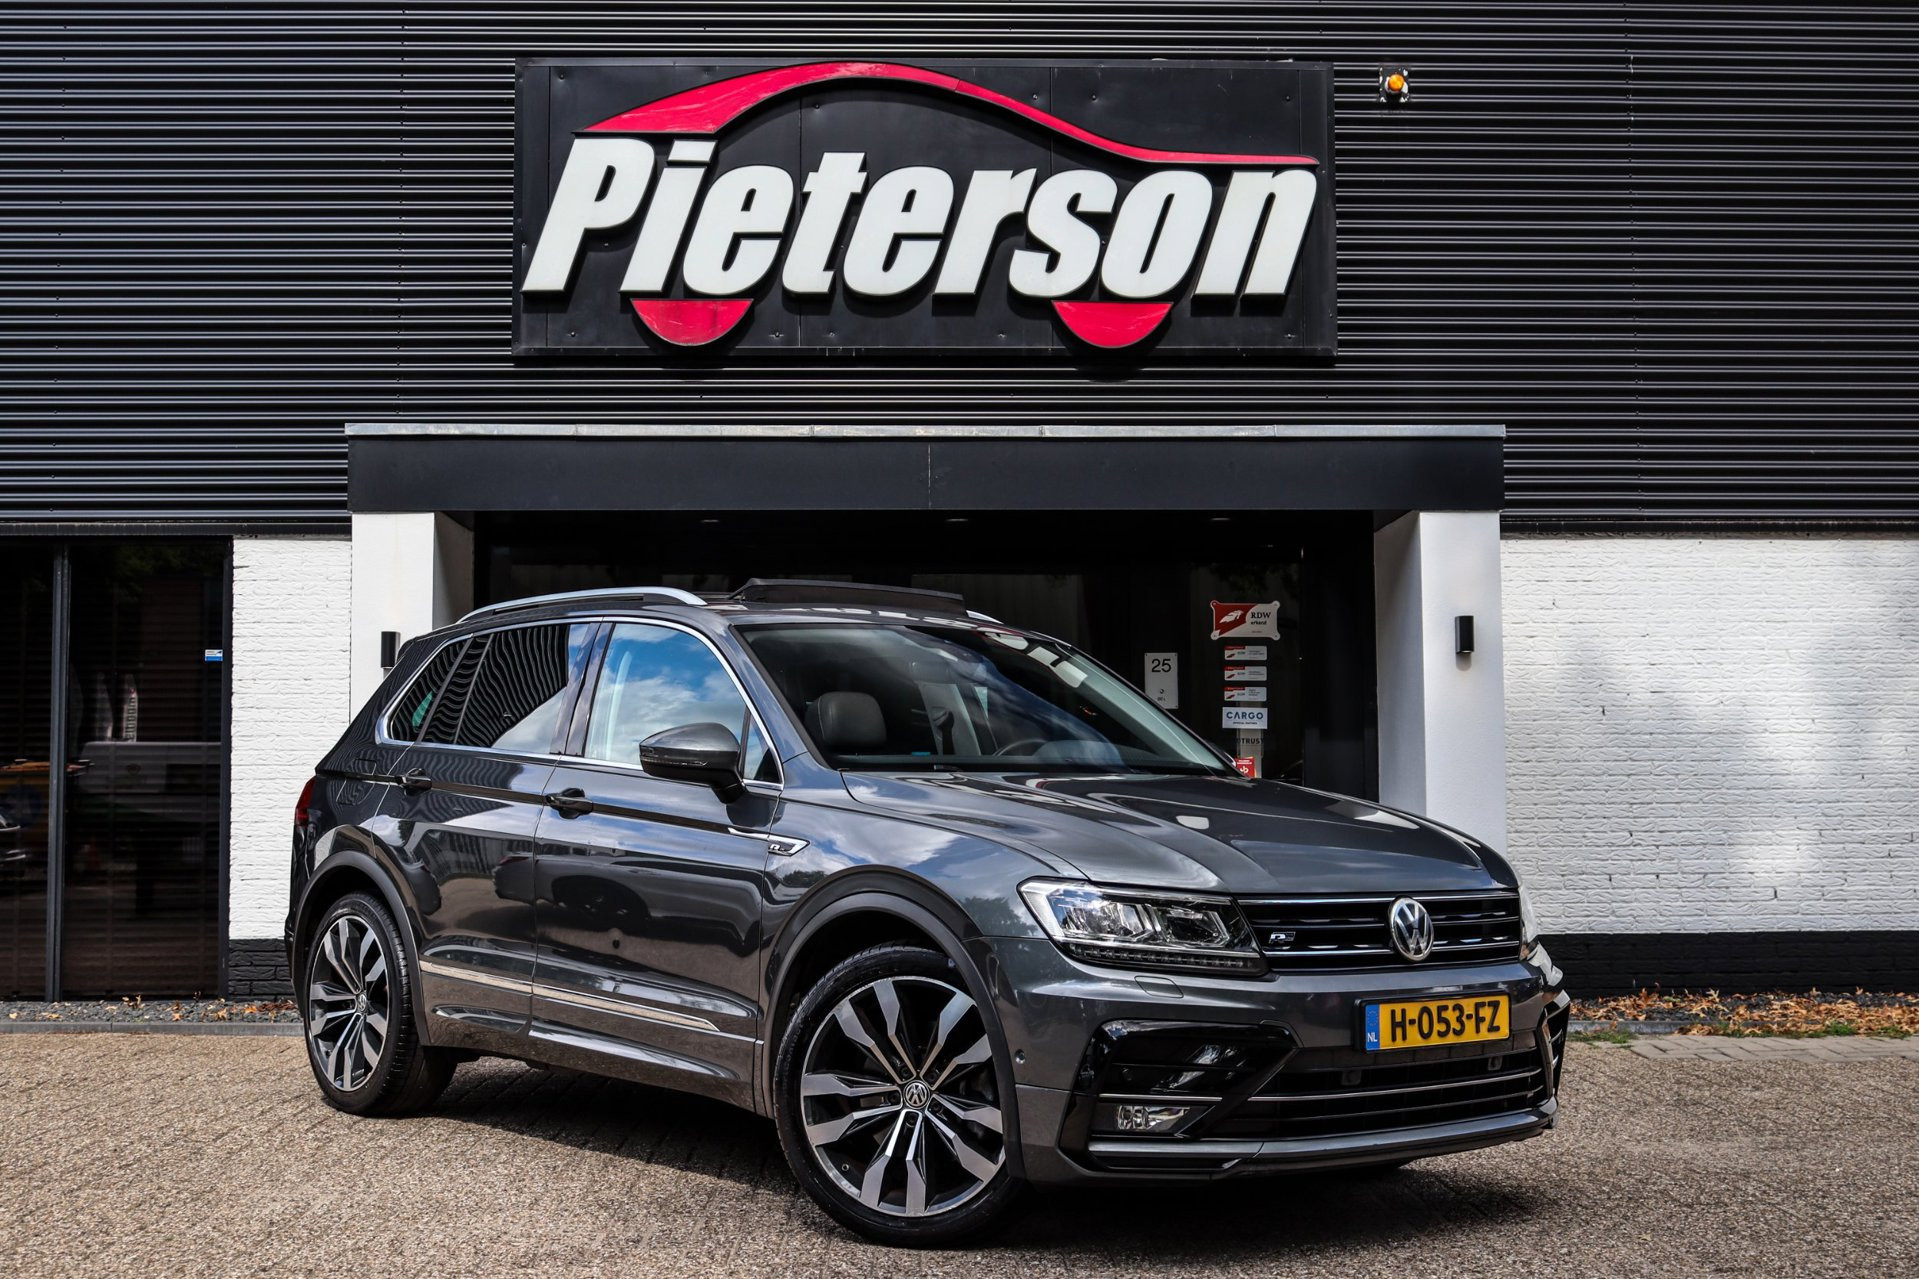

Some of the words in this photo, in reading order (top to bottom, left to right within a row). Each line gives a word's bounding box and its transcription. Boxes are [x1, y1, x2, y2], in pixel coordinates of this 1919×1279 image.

[520, 136, 1318, 299] Pieterson
[1250, 611, 1271, 619] RDW
[1151, 658, 1172, 673] 25
[1226, 711, 1264, 720] CARGO
[1390, 1000, 1501, 1042] H-053-FZ
[1366, 1032, 1378, 1042] NL
